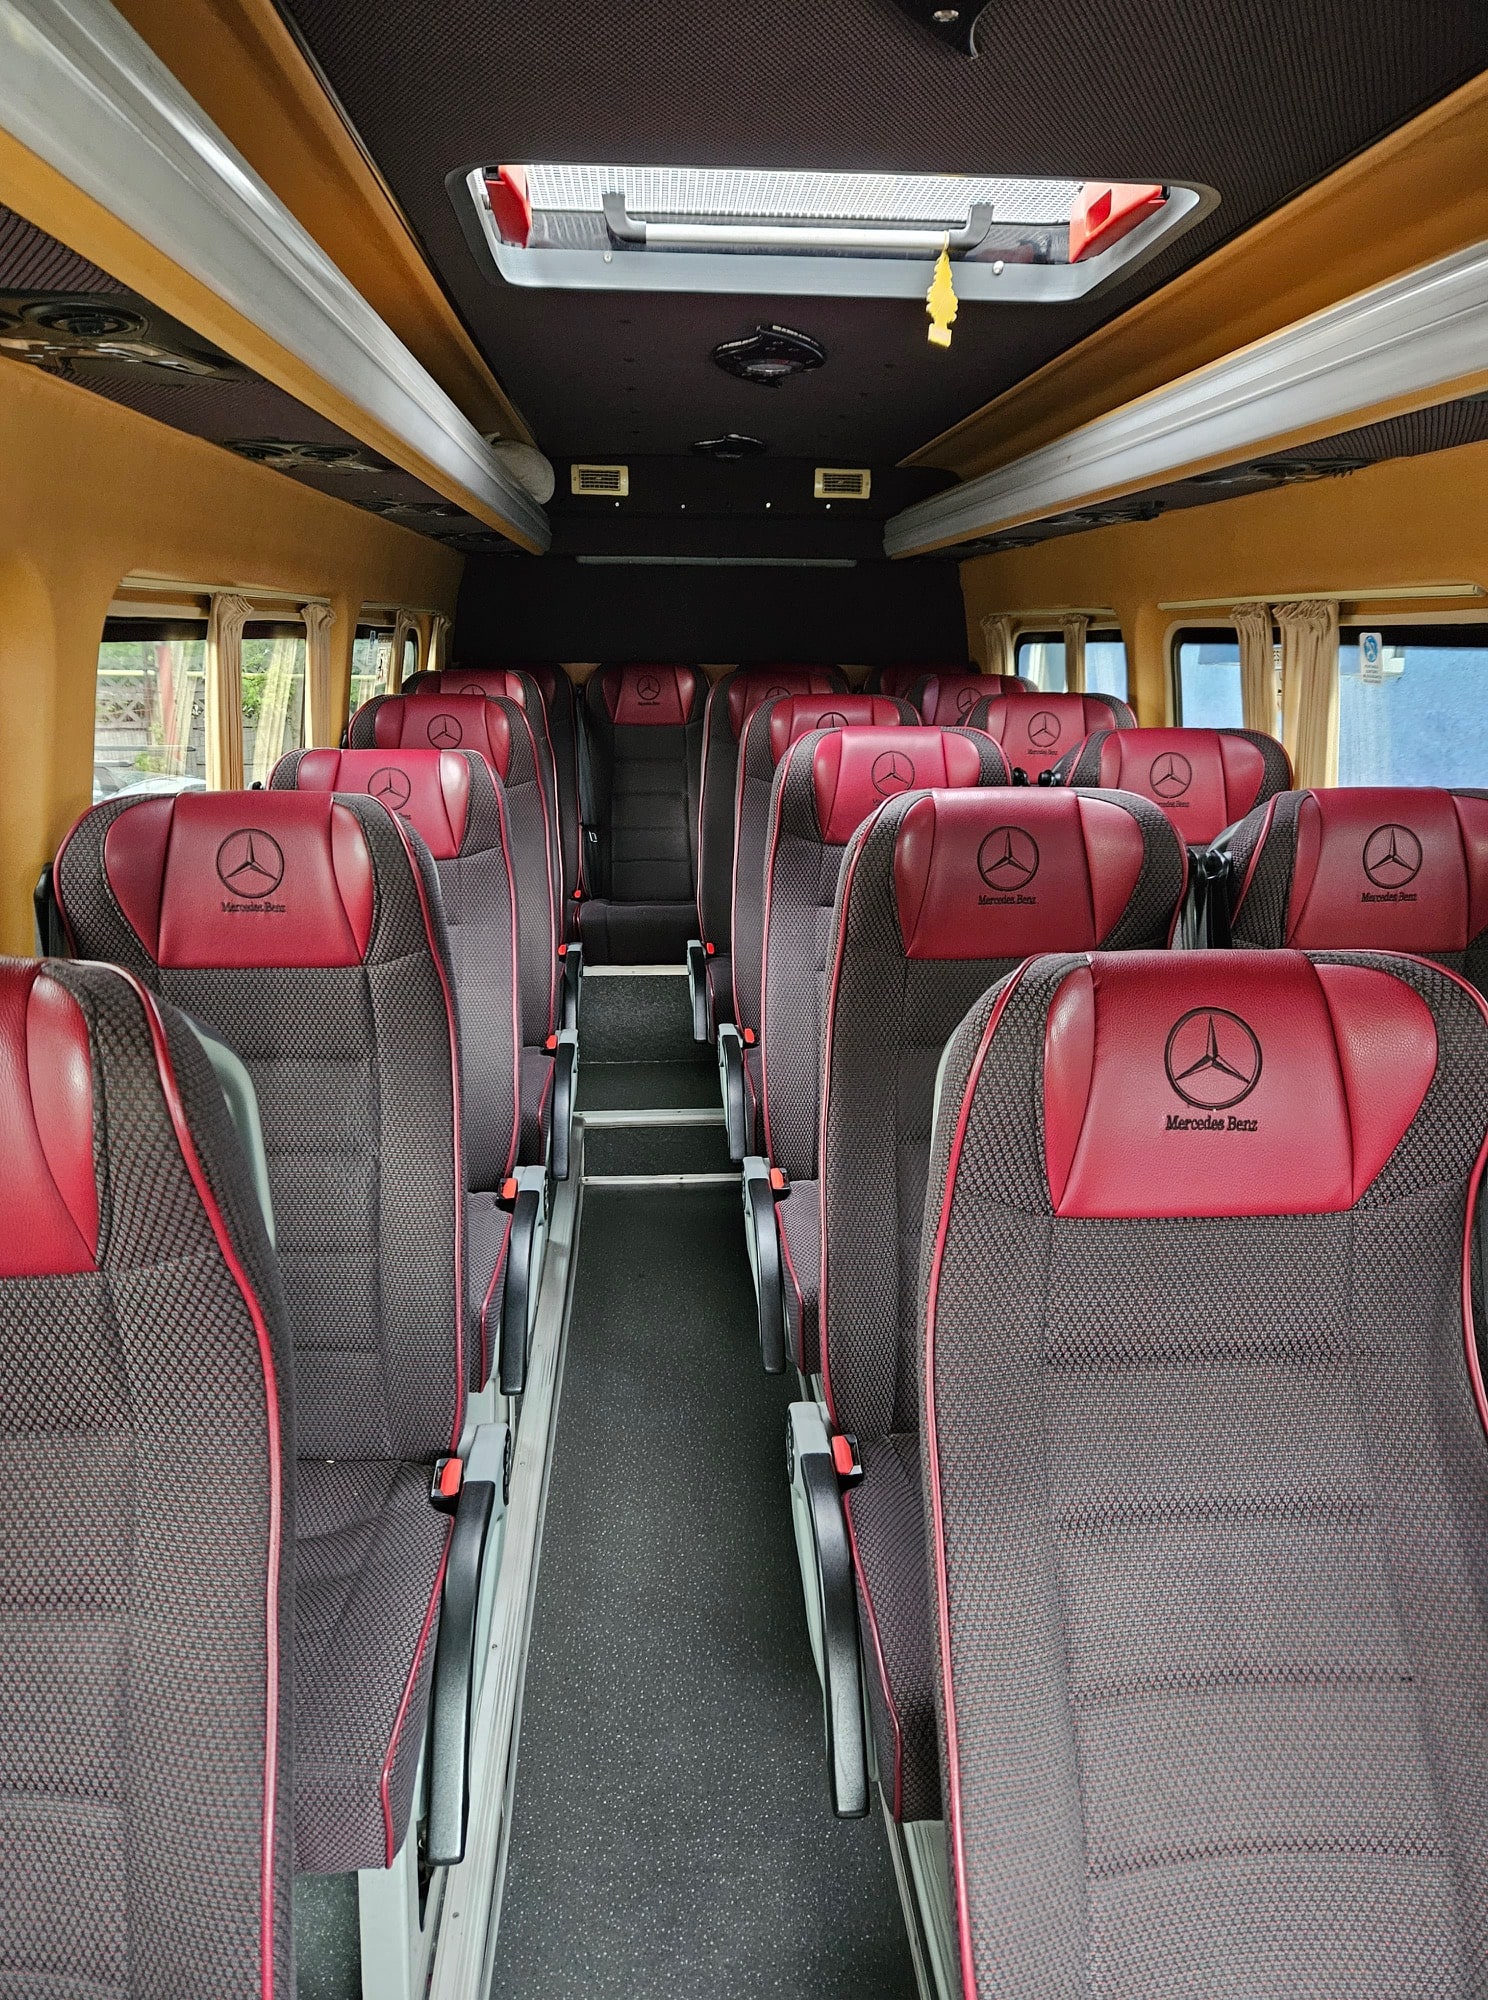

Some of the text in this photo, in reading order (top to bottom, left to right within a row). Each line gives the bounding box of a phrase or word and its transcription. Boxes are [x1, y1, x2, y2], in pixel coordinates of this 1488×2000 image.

[978, 894, 1036, 905] Mercedes Benz
[1361, 892, 1417, 903] Mercedes Benz
[221, 901, 286, 913] Mercedes Benz
[1165, 1114, 1258, 1132] Mercedes Benz
